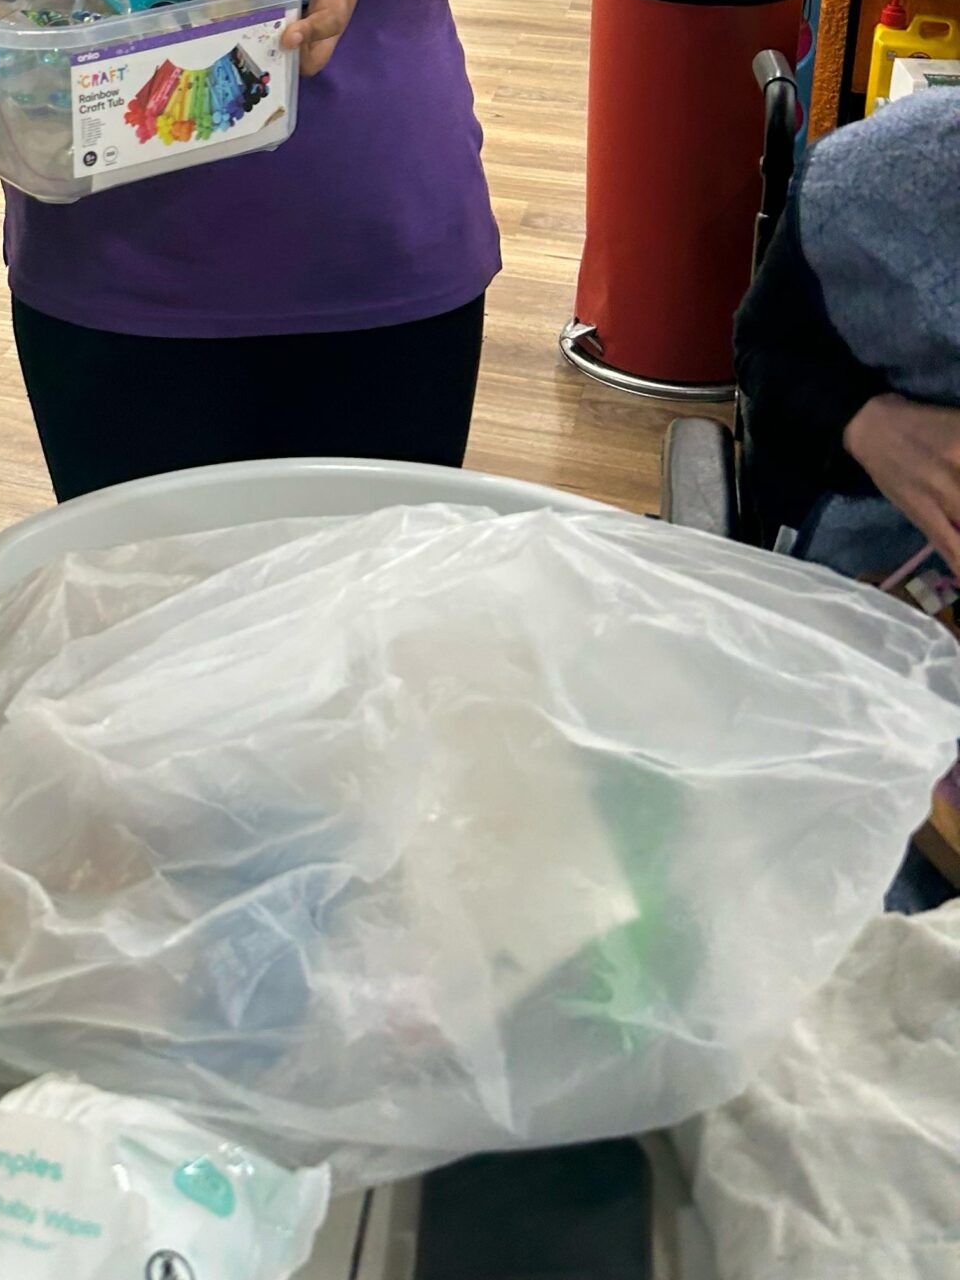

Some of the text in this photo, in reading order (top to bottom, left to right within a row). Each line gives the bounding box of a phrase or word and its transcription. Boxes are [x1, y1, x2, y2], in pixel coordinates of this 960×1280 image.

[77, 51, 100, 63] anko
[79, 67, 126, 89] CRAFT
[79, 88, 120, 104] Rainbow
[79, 97, 125, 114] Craft Tub
